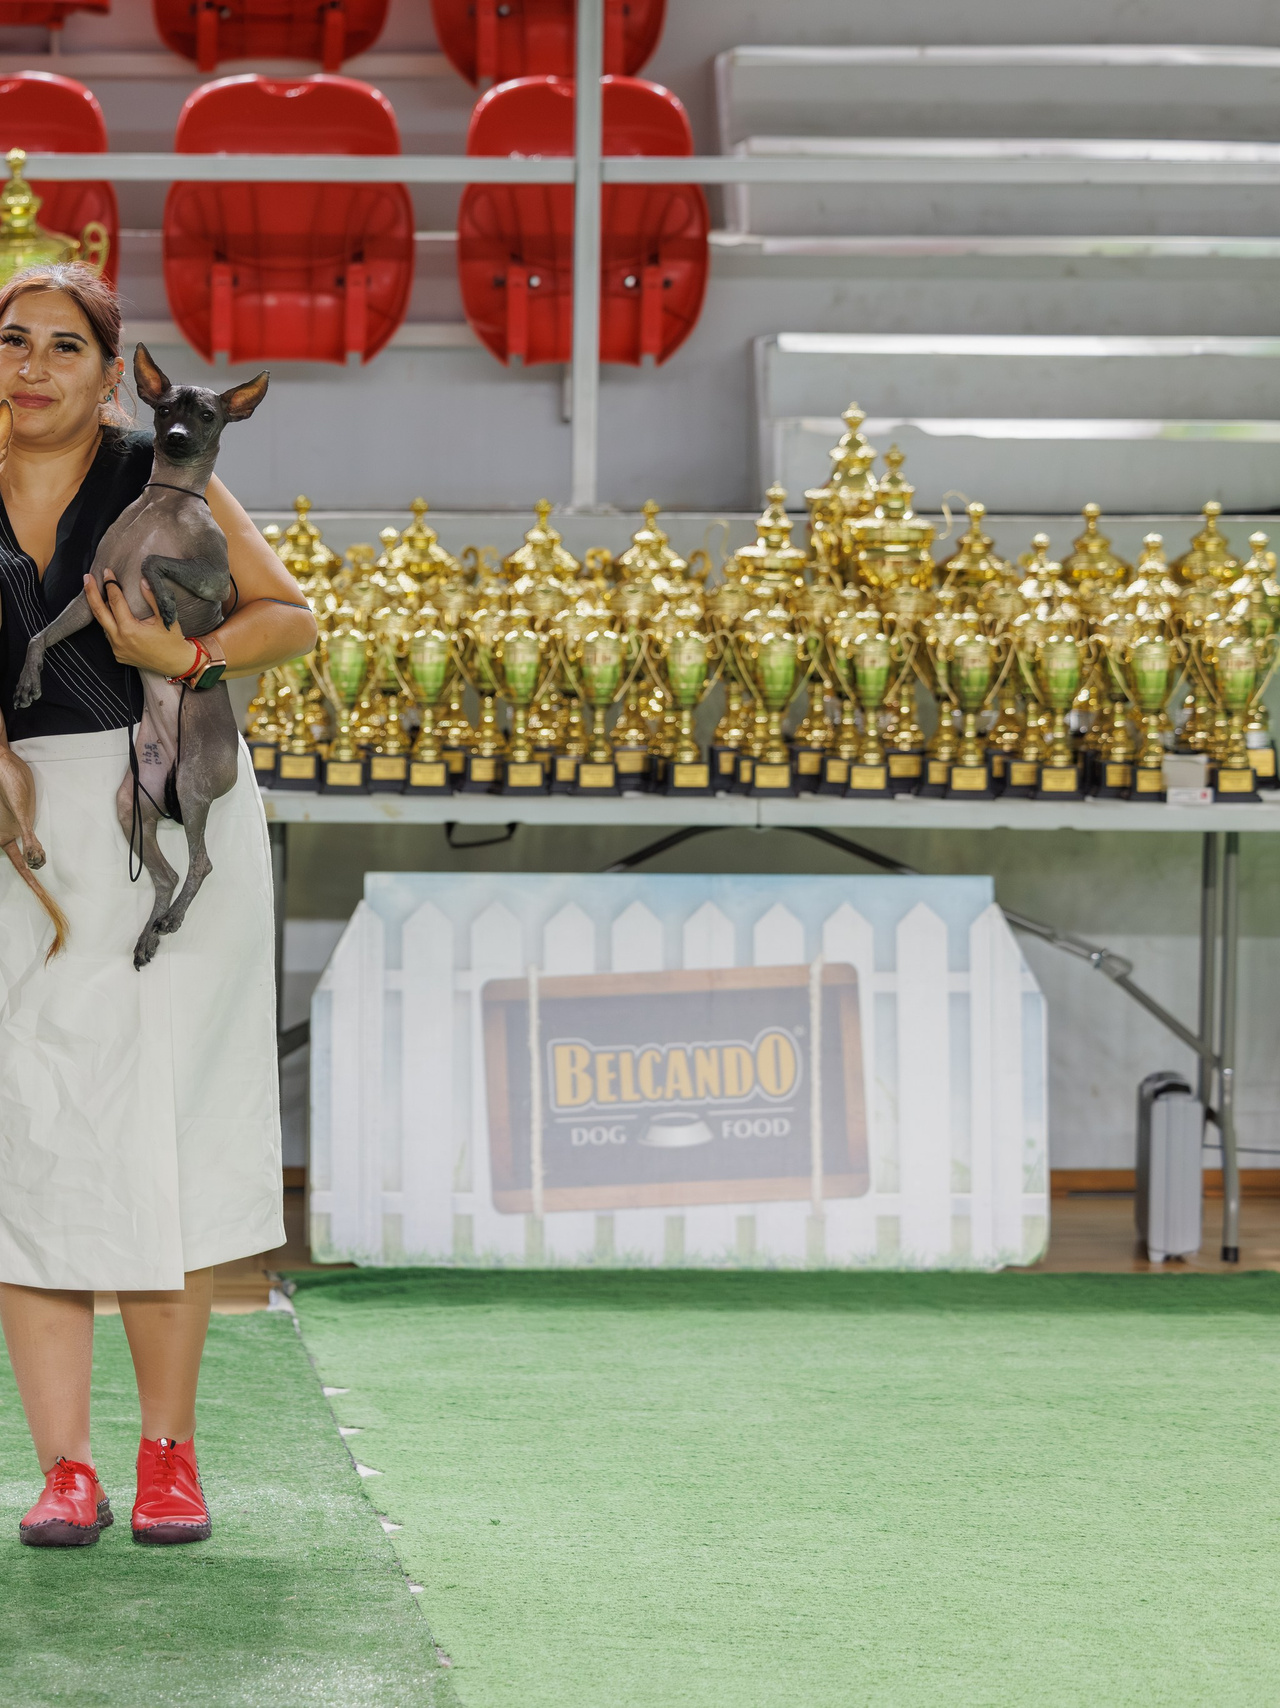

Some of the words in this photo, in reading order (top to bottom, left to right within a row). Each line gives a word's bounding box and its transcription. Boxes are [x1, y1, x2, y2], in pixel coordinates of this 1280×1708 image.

[550, 1030, 799, 1109] BELCANDO
[570, 1125, 628, 1147] DOG
[721, 1118, 792, 1140] FOOD
